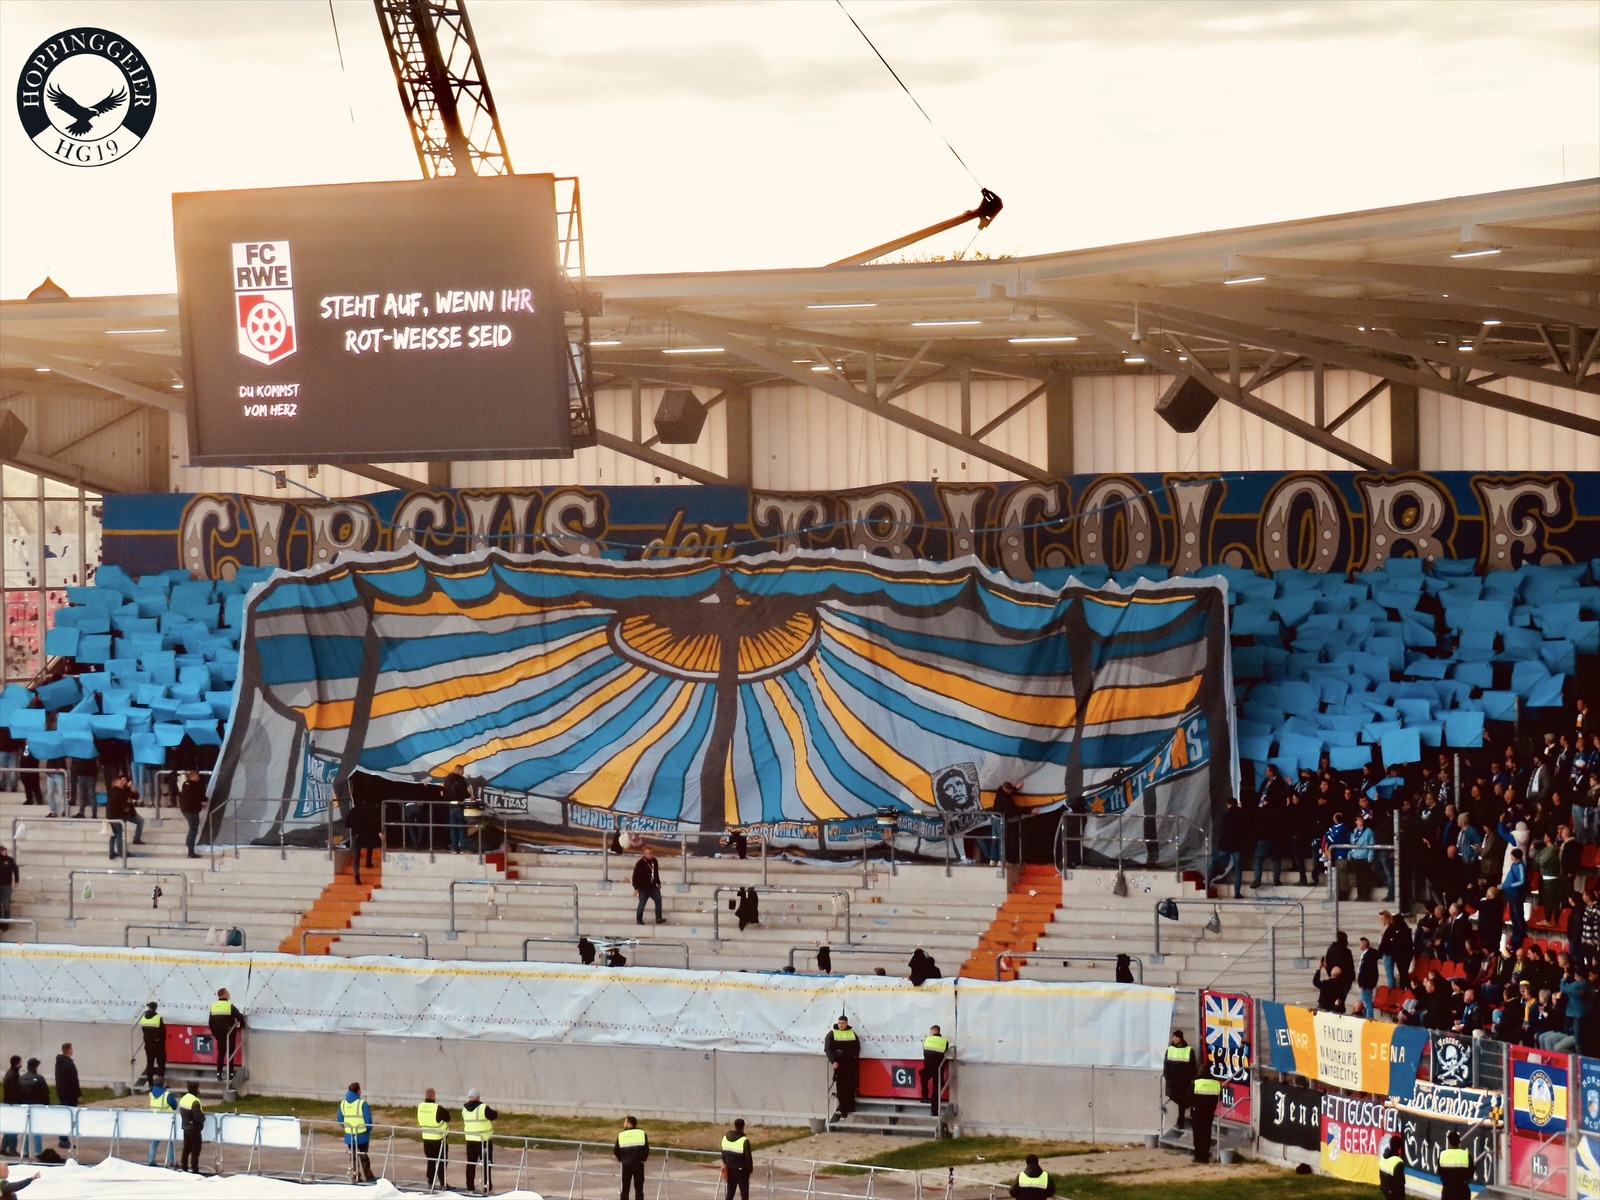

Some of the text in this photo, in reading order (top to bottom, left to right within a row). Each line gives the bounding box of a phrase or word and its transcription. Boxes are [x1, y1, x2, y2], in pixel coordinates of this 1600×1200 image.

[245, 243, 277, 265] FC
[236, 265, 289, 287] RWE
[320, 288, 535, 320] STEHT AUF, WENN IHR
[345, 324, 513, 354] ROT-WEISSE SEID
[239, 383, 301, 398] DU KOMMST
[243, 403, 298, 417] VOM HERZ
[178, 471, 1577, 583] CIRCUS der TRICOLORE
[197, 1036, 210, 1051] F1
[1369, 1042, 1405, 1063] JENA
[1320, 1046, 1358, 1066] NAUMBURG
[896, 1068, 912, 1085] G1
[1273, 1090, 1319, 1128] Jena
[1344, 1127, 1377, 1155] GERA
